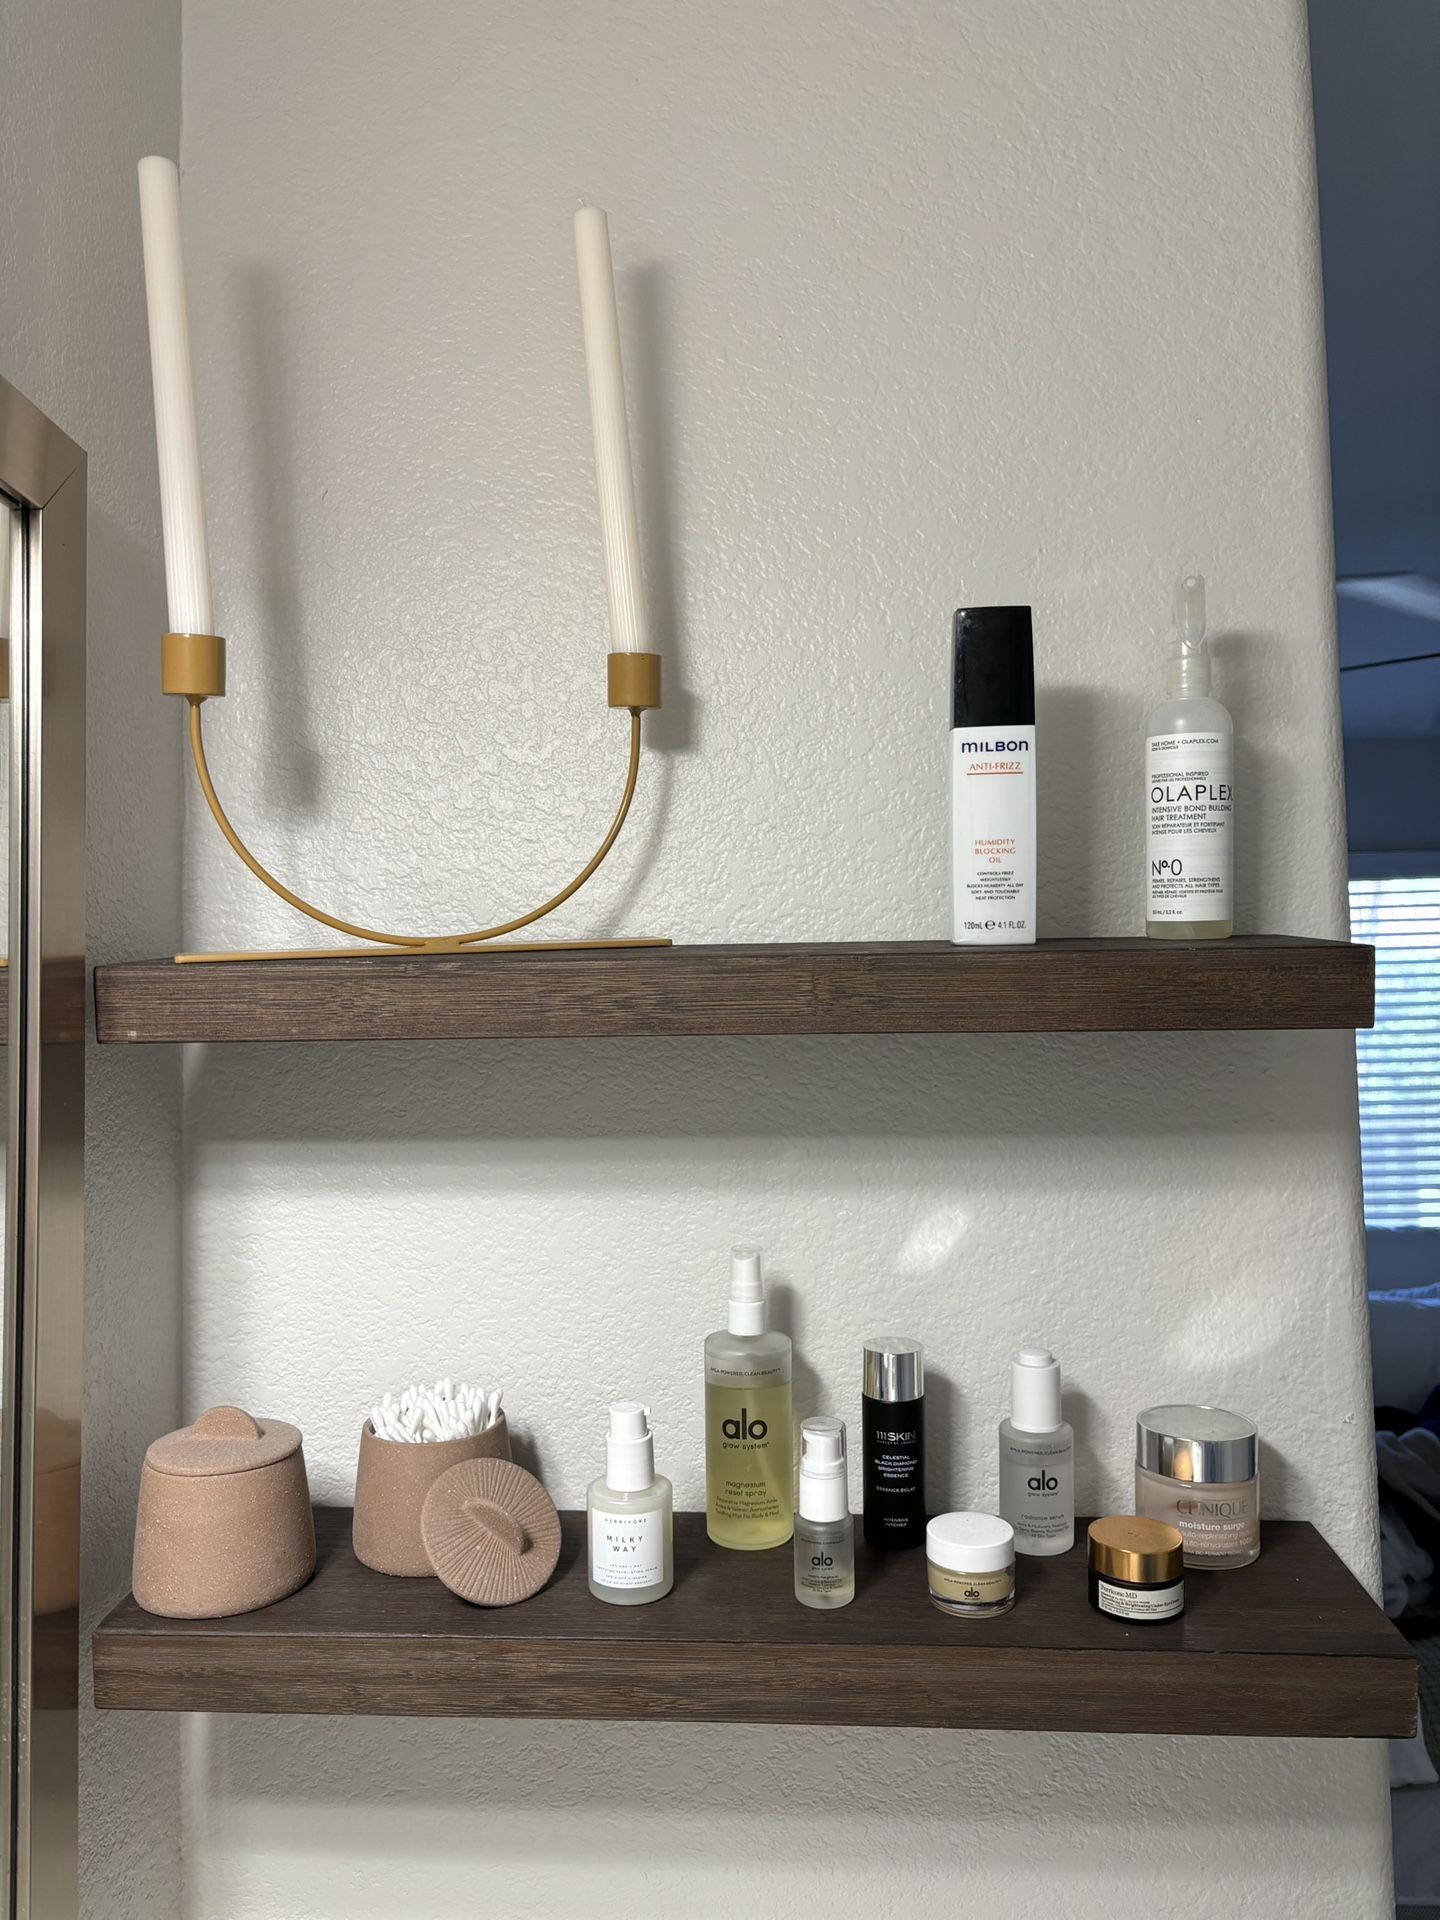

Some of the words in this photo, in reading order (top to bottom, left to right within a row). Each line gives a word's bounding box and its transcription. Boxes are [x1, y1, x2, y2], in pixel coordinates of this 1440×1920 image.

[969, 761, 1021, 771] ANTI-FRIZZ
[1151, 784, 1233, 804] OLAPLEX
[1152, 805, 1182, 814] INTENSIVE
[1184, 804, 1207, 812] BOND
[1166, 813, 1207, 821] TREATMENT
[975, 838, 1016, 847] HUMIDITY
[974, 847, 1016, 855] BLOCKING
[998, 921, 1007, 929] 4.1
[722, 1407, 768, 1440] alo
[725, 1481, 766, 1489] magnesium
[1028, 1469, 1058, 1491] alo
[745, 1490, 767, 1498] spray
[1177, 1499, 1248, 1519] CLINIQUE
[1179, 1520, 1220, 1531] moisture
[1223, 1522, 1245, 1531] surge
[607, 1535, 643, 1543] MILKY
[812, 1551, 833, 1566] alo
[964, 1586, 980, 1598] alo
